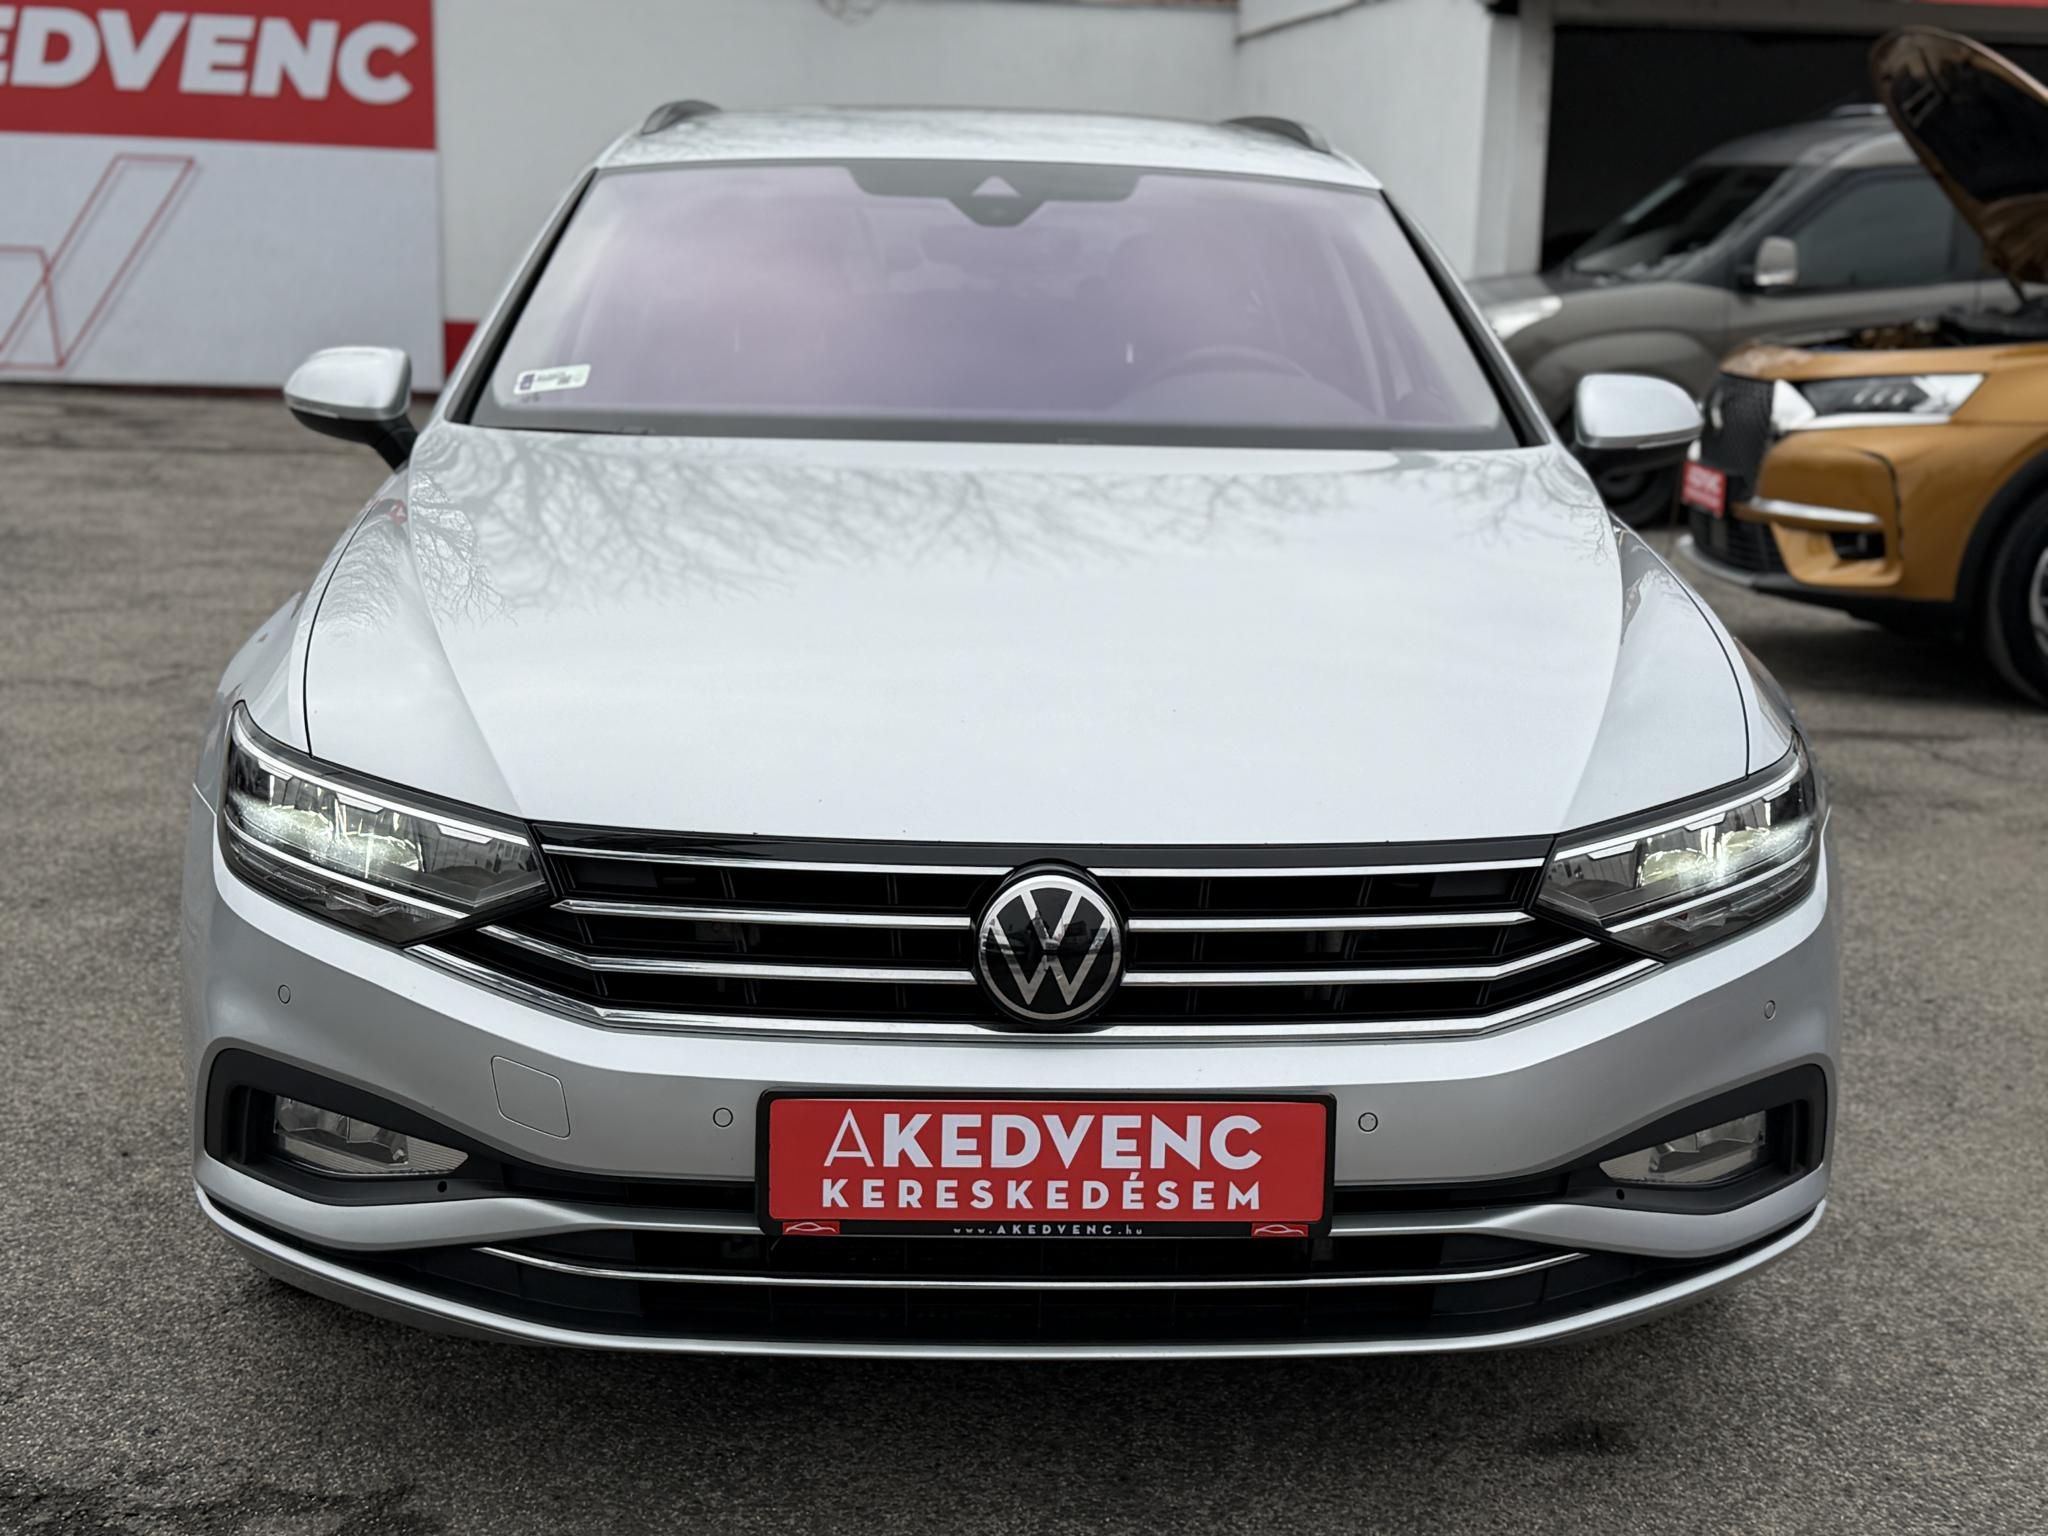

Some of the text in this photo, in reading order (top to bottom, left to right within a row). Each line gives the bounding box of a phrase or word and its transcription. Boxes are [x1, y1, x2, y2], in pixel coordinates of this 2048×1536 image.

[0, 5, 419, 105] DVENC
[983, 880, 1117, 1011] VW
[823, 1108, 1262, 1170] AKEDVENC
[822, 1171, 1260, 1210] KERESKEDÉSEM
[953, 1224, 1143, 1235] www.AKEDVENC.hu
